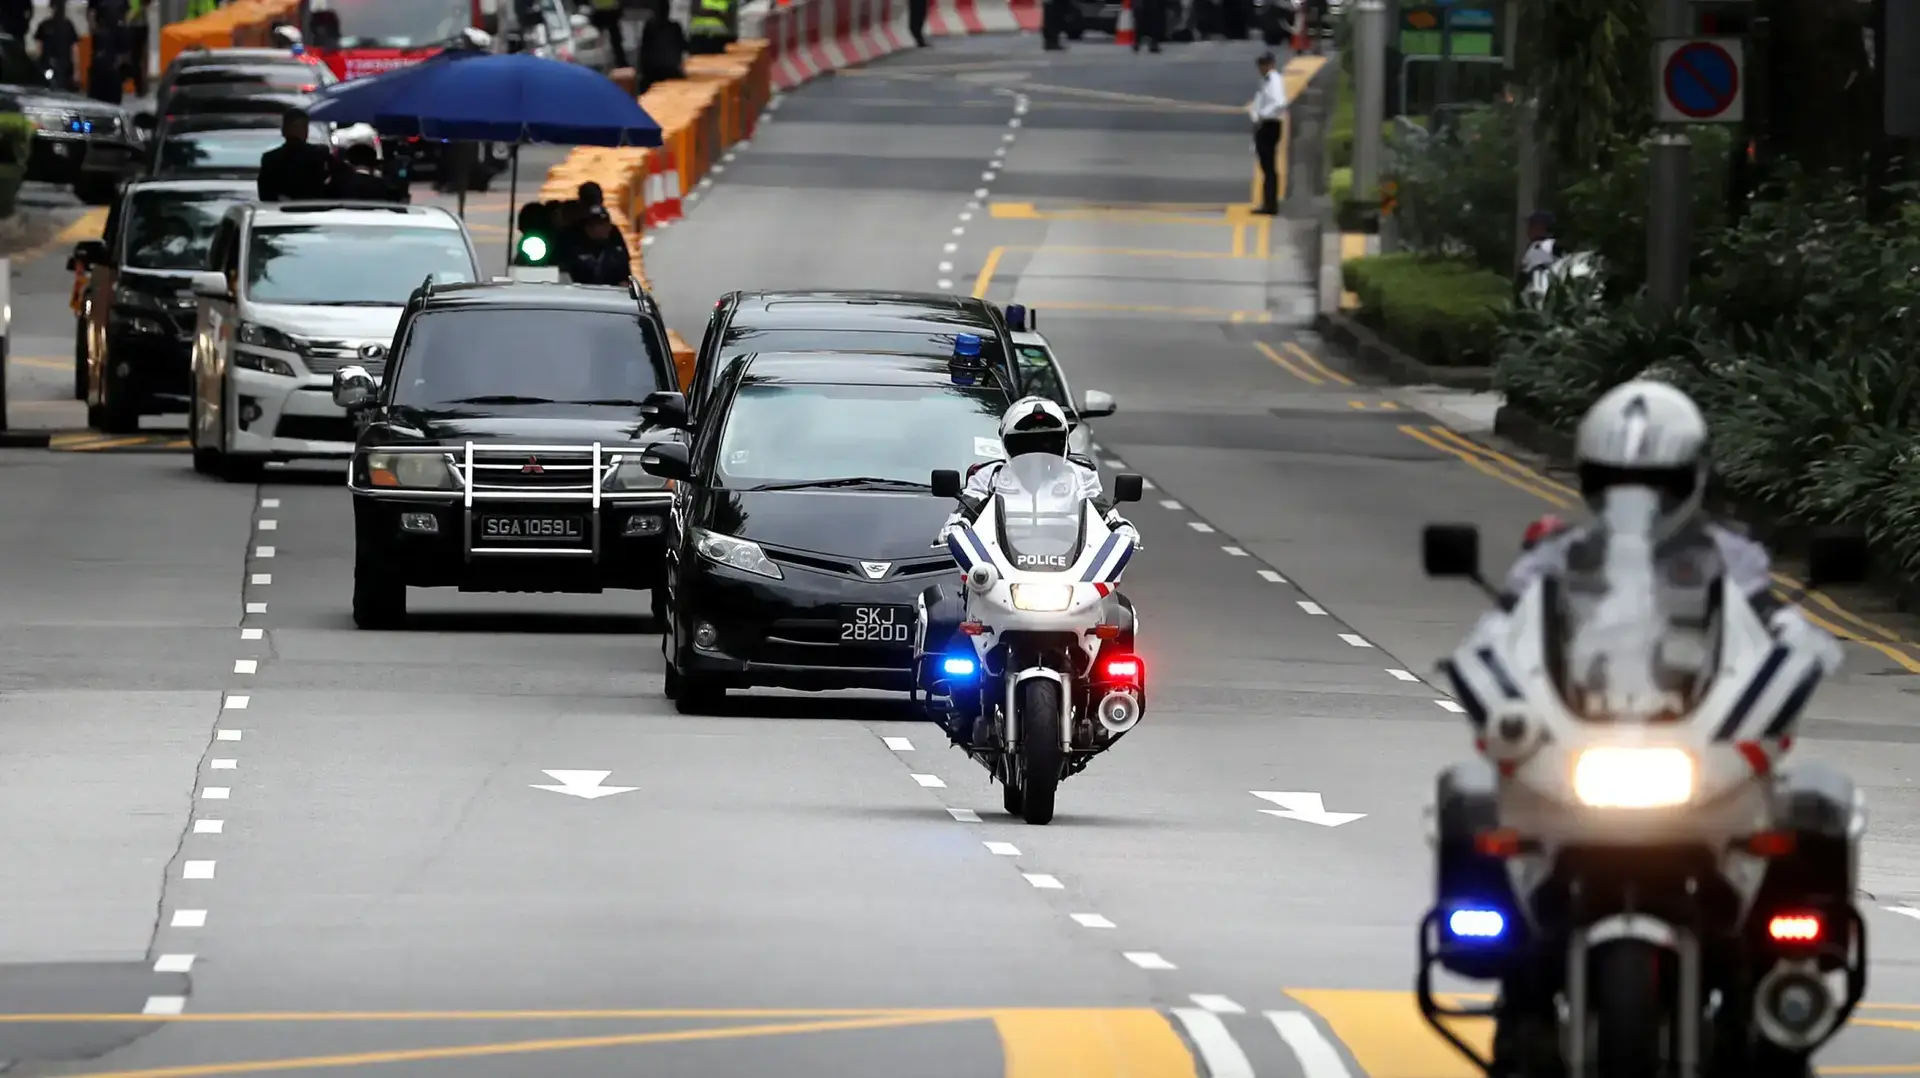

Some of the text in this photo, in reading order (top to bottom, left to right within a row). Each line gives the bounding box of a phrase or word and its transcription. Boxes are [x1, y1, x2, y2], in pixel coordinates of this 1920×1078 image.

[1017, 555, 1067, 567] POLICE
[856, 607, 895, 625] SKJ
[841, 623, 908, 641] 2820D
